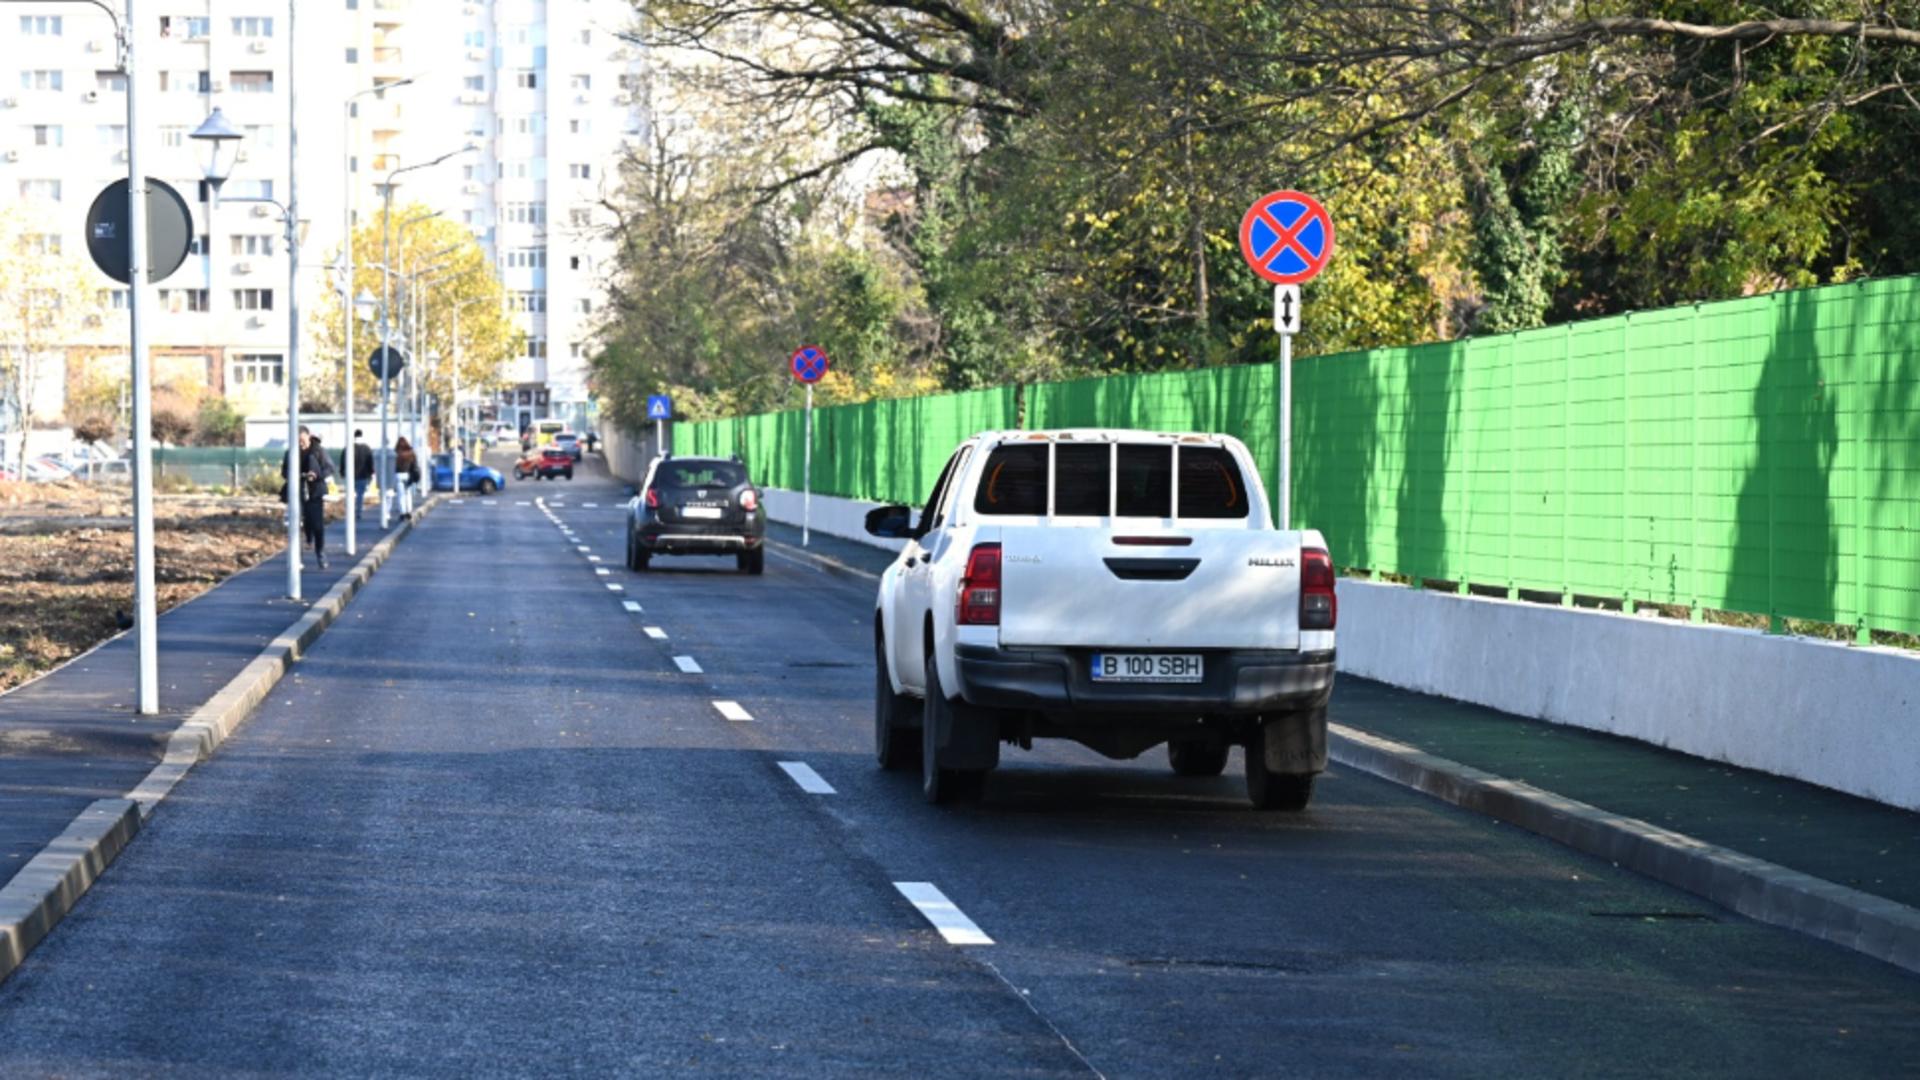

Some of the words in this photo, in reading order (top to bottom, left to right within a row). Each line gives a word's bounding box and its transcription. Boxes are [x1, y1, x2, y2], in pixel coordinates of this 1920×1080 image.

[1104, 656, 1118, 675] B
[1125, 656, 1153, 675] 100
[1158, 656, 1199, 675] SBH
